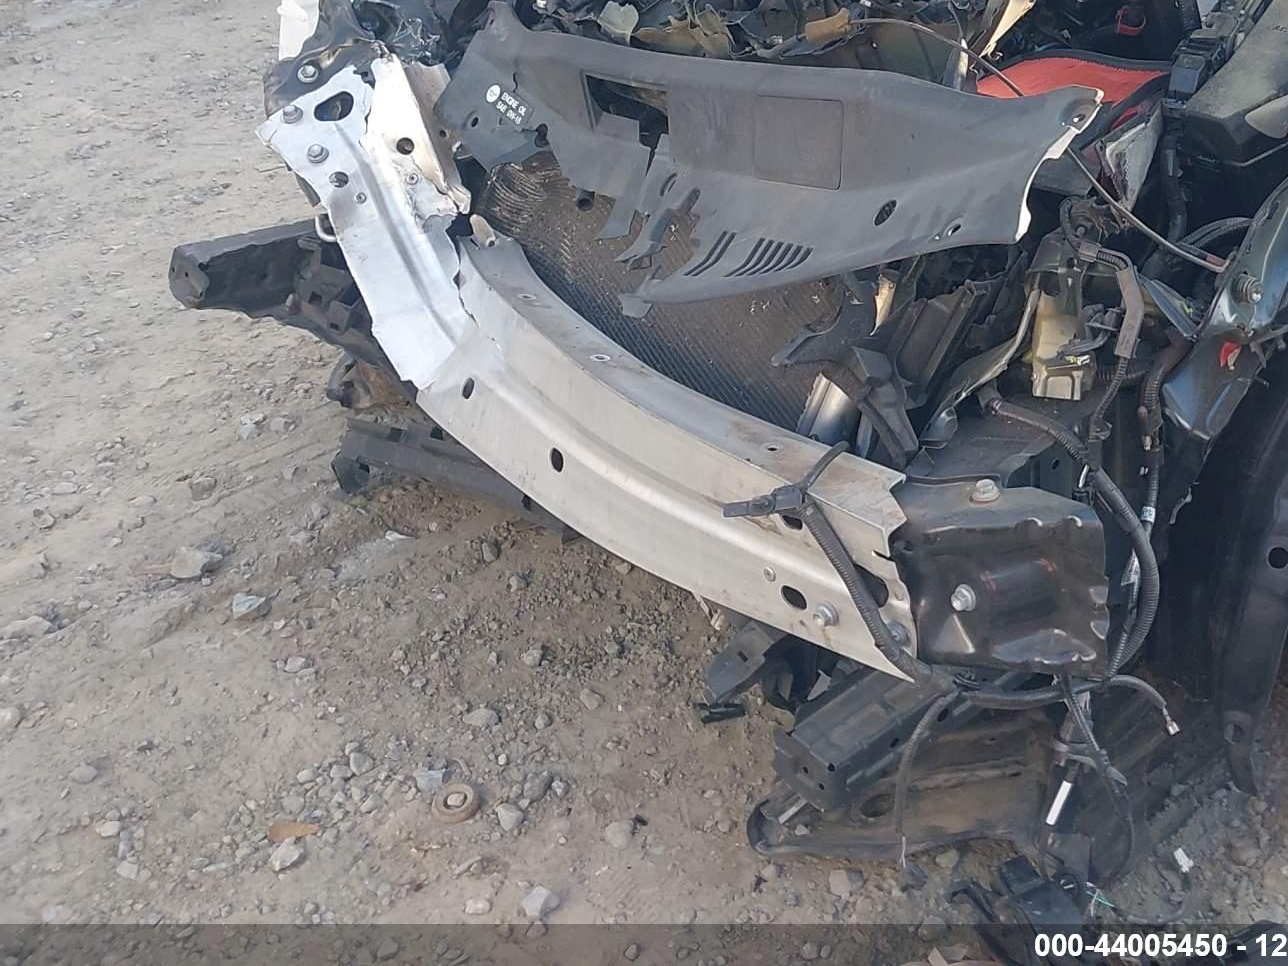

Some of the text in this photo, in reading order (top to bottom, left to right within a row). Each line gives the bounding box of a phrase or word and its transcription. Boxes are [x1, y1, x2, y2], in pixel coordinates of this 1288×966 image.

[496, 101, 508, 112] SAE
[502, 93, 527, 116] ENGINE OIL
